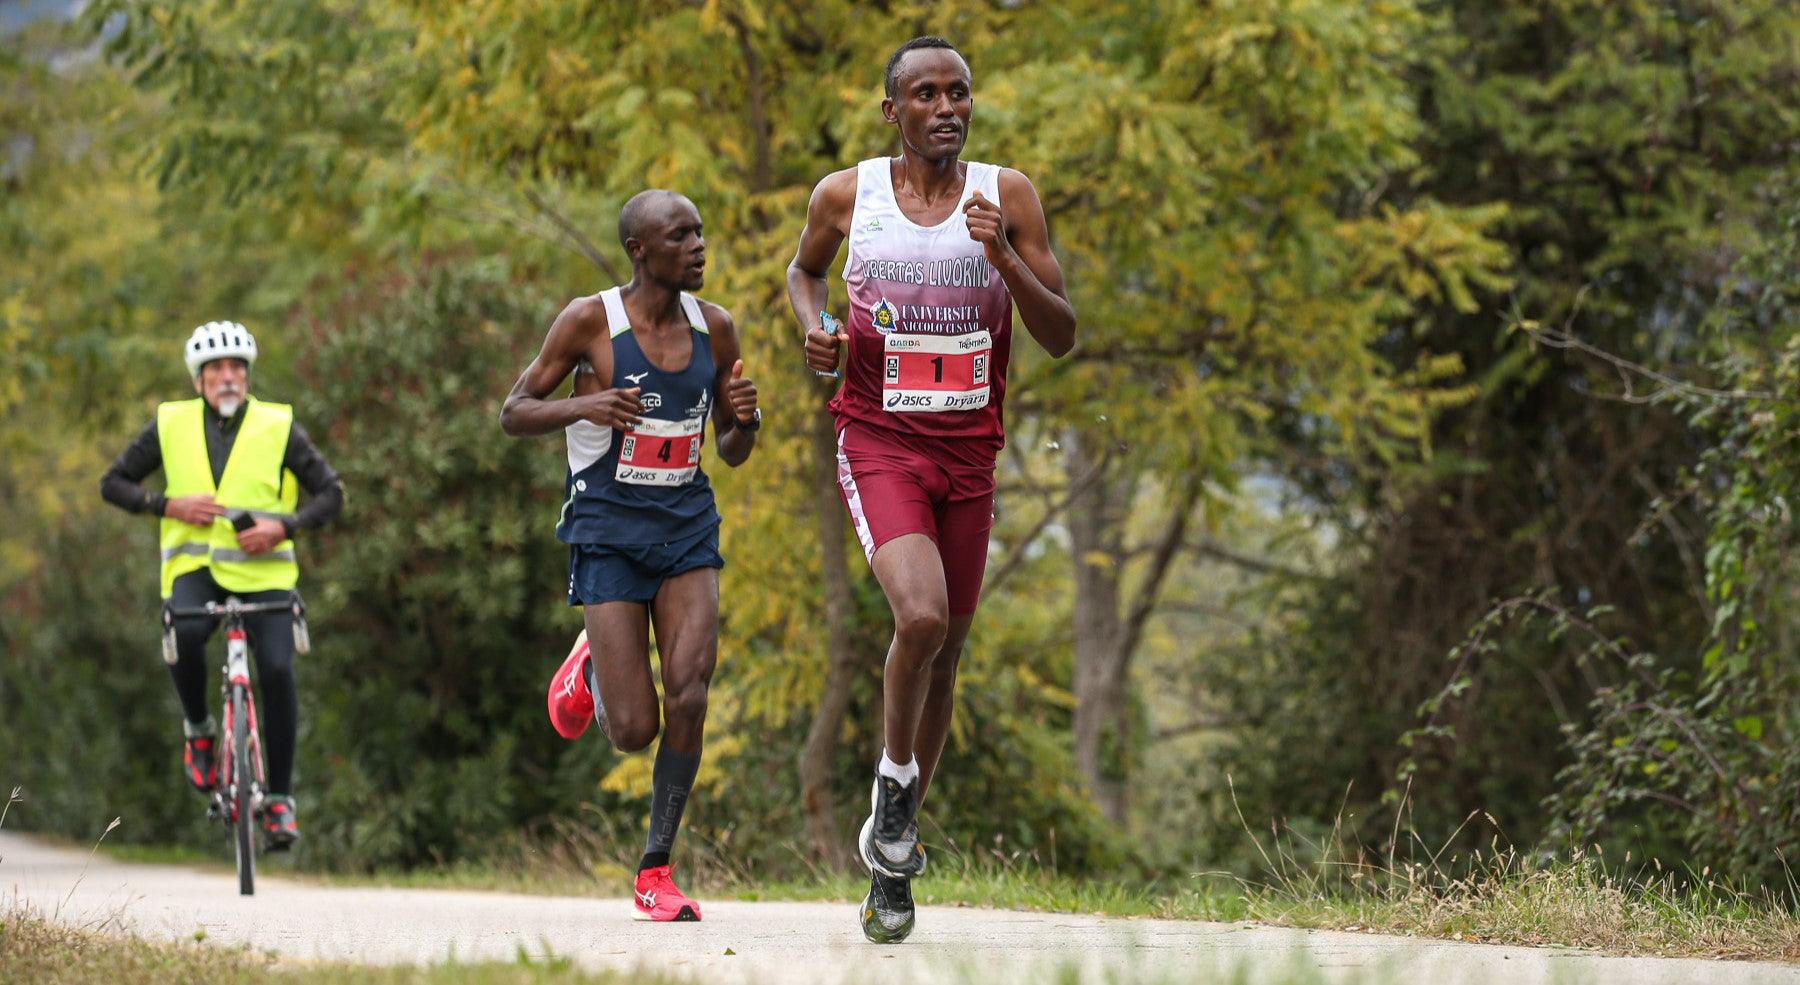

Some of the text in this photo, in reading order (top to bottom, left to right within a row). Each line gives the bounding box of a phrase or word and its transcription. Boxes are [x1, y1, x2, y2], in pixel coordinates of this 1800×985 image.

[860, 255, 990, 288] LIBERTAS LIVORNO
[890, 339, 920, 347] GARDA
[931, 356, 943, 383] 1
[944, 394, 986, 408] Dryarn
[657, 440, 672, 463] 4
